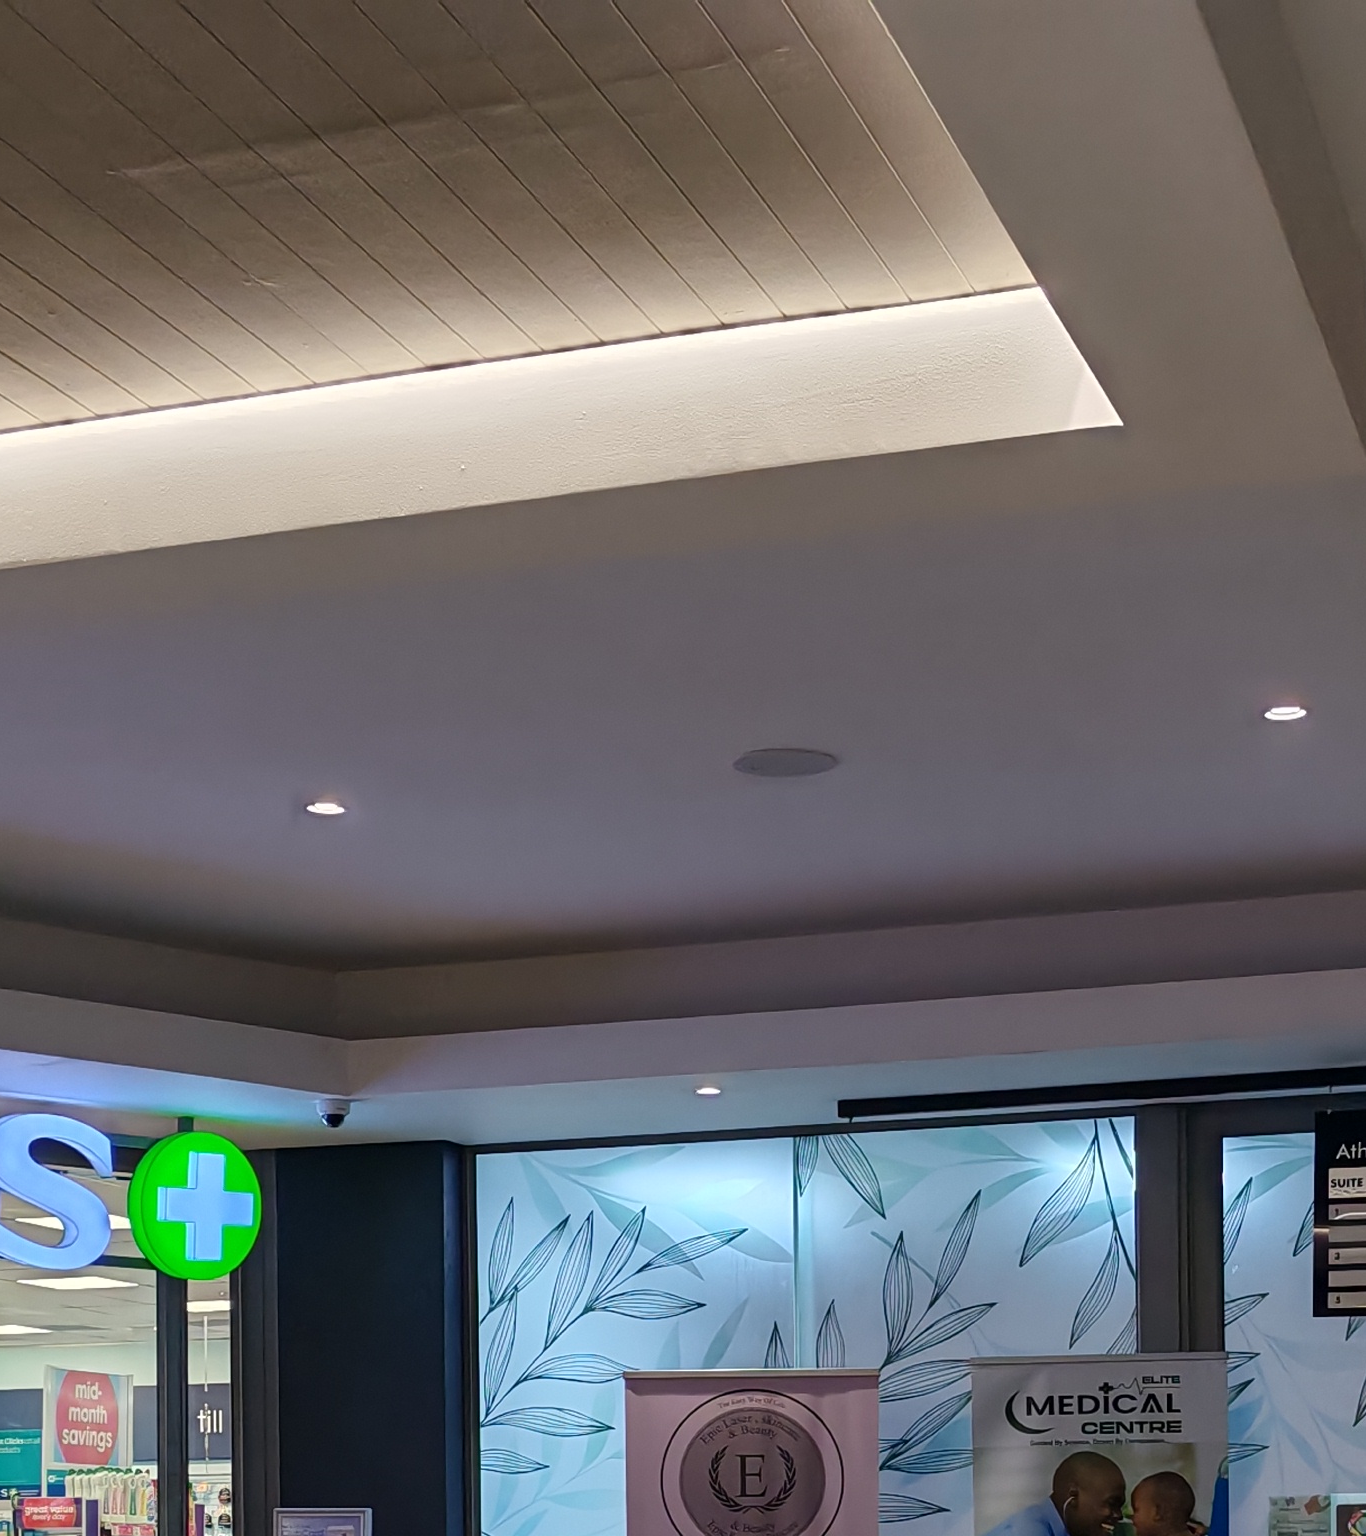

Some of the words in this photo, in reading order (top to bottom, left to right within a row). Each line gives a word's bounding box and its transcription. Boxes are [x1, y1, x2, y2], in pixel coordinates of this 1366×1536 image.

[1331, 1177, 1363, 1188] SUITE
[1142, 1375, 1181, 1384] ELITE
[75, 1382, 102, 1400] mid-
[1026, 1393, 1182, 1416] MEDICAL
[68, 1406, 108, 1424] month
[197, 1409, 223, 1433] till
[700, 1425, 723, 1445] Epic
[728, 1429, 737, 1439] &
[741, 1424, 777, 1440] Beauty
[1081, 1420, 1182, 1435] CENTRE
[62, 1427, 113, 1453] savings
[736, 1454, 768, 1498] E
[25, 1505, 48, 1516] great
[50, 1505, 74, 1514] value
